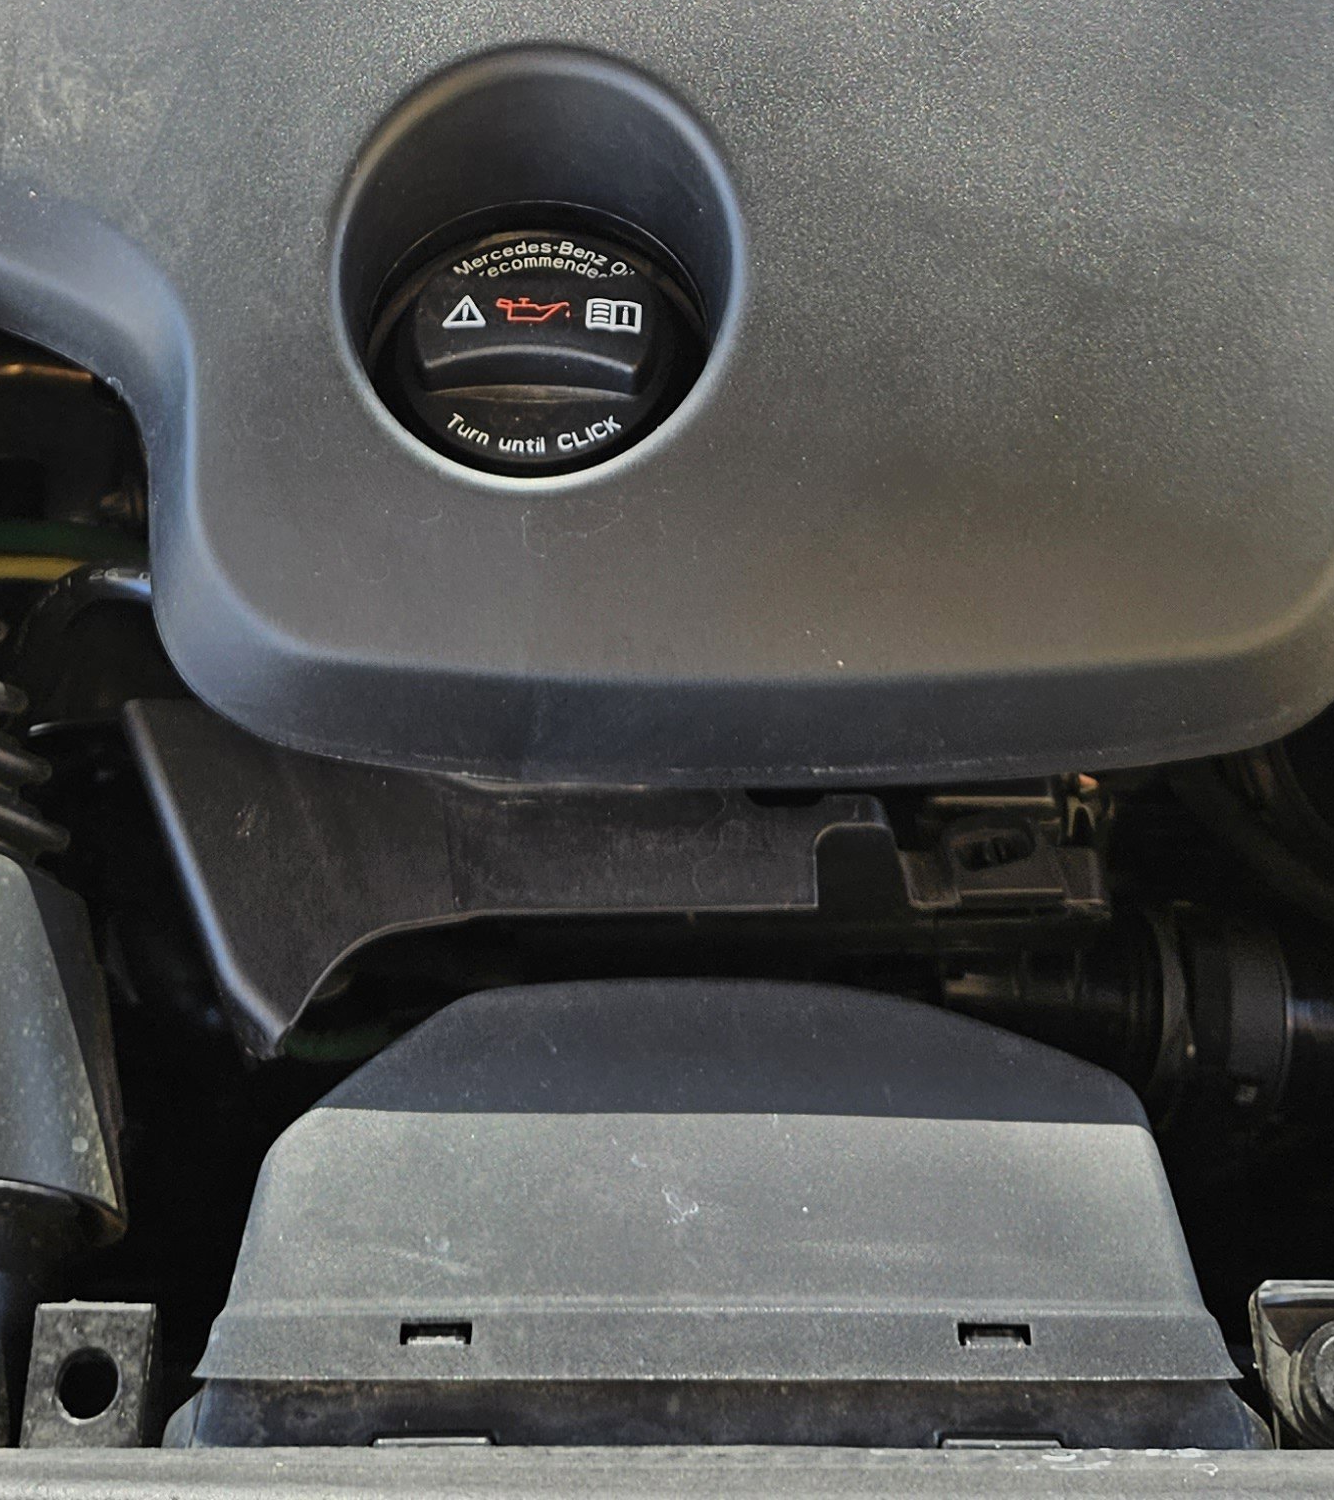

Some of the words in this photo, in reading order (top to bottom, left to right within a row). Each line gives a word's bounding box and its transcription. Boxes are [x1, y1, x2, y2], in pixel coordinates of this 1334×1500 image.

[452, 240, 609, 276] Mercedes-Benz
[446, 412, 490, 446] Turn
[498, 436, 546, 454] until
[556, 414, 622, 450] CLICK
